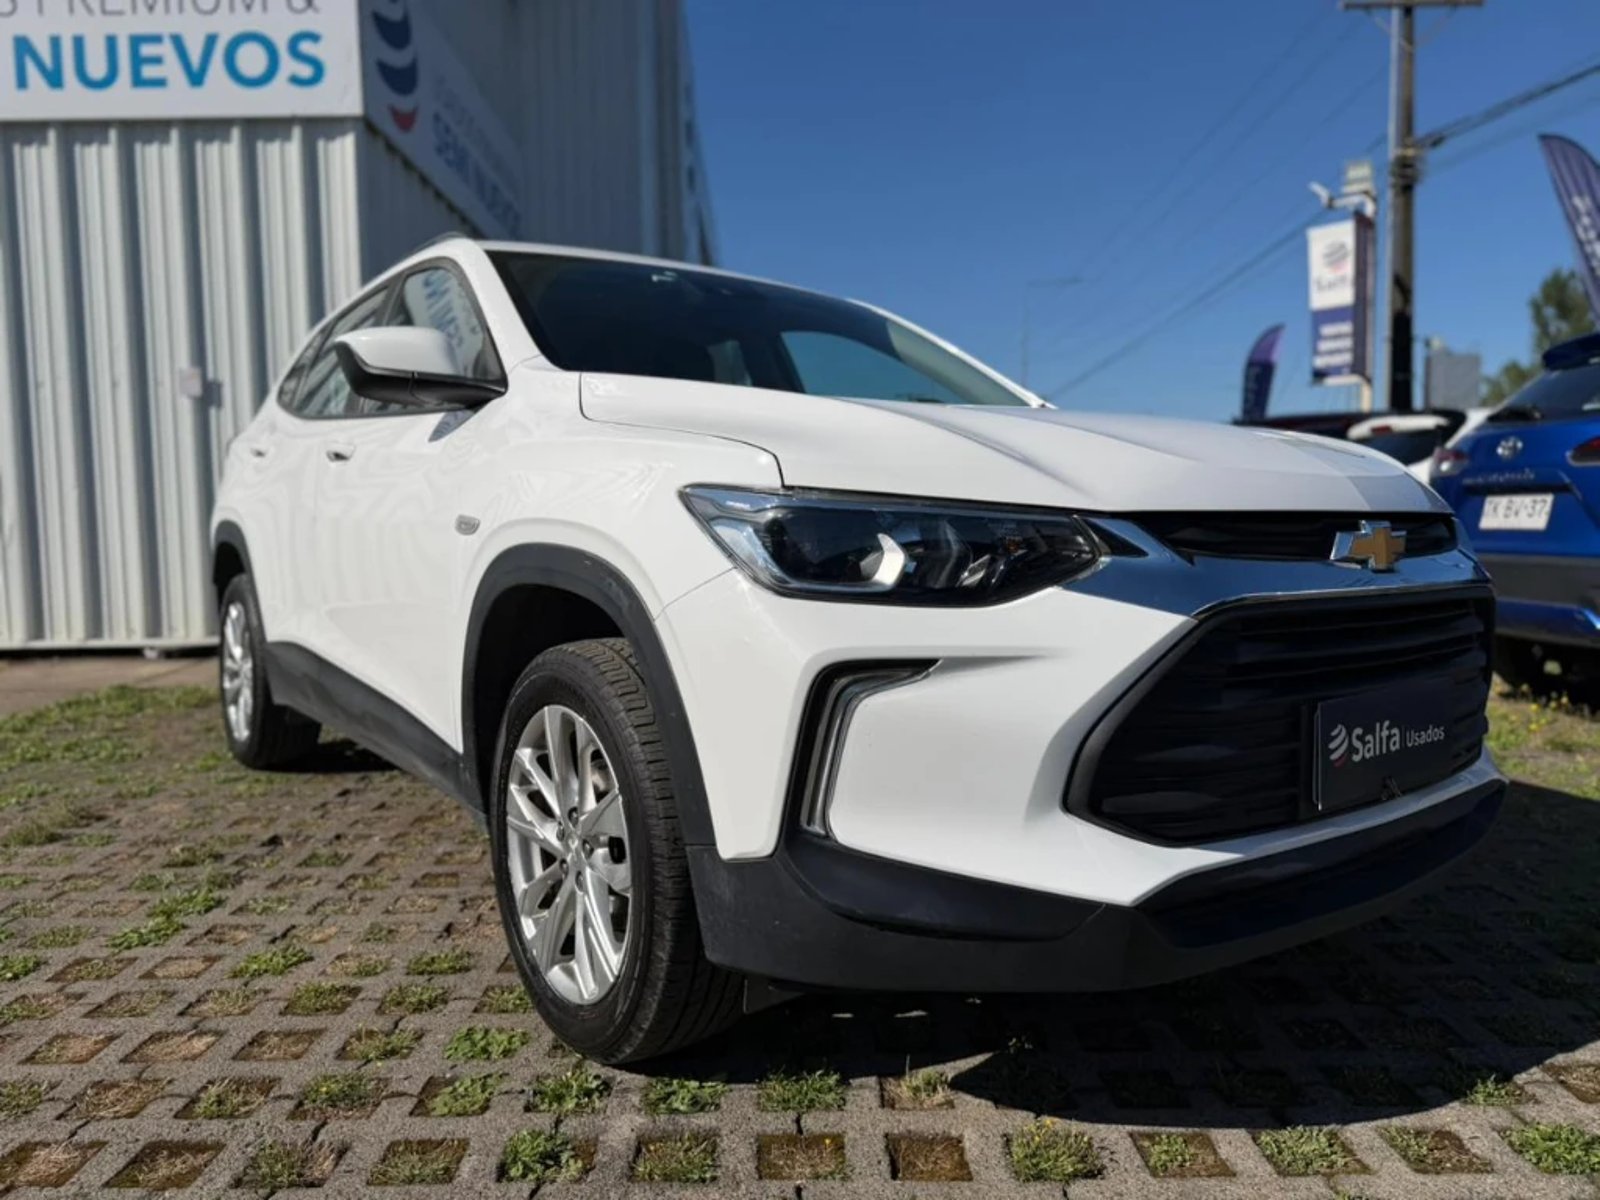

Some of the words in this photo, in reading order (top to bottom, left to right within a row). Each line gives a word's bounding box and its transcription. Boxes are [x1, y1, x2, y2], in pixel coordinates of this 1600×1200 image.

[13, 31, 326, 90] NUEVOS
[1351, 719, 1400, 762] Salfa
[1406, 724, 1446, 748] Usados
